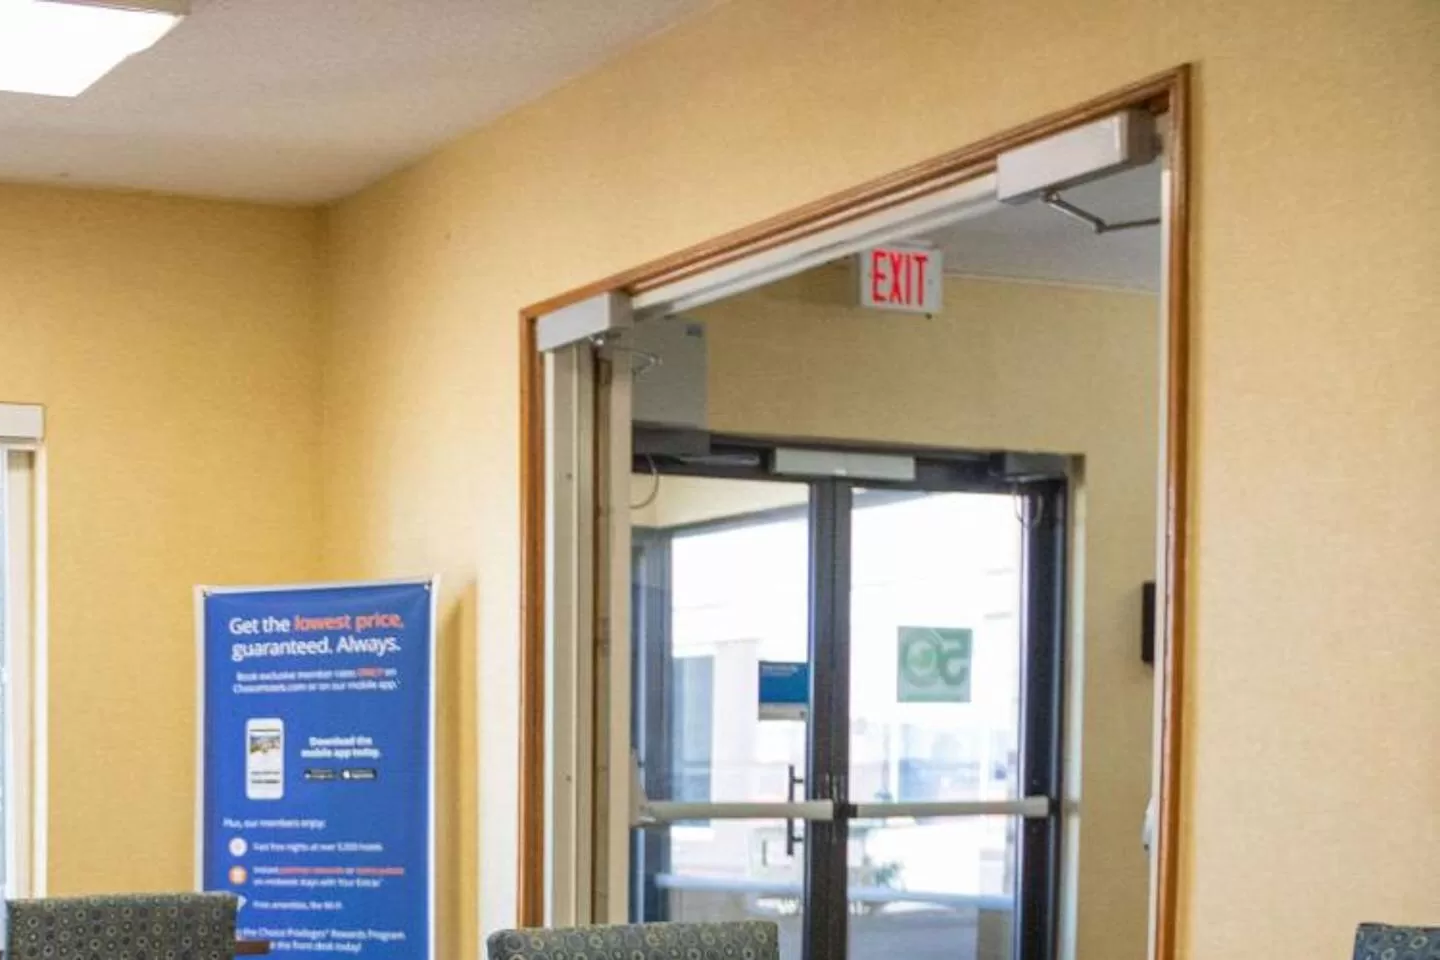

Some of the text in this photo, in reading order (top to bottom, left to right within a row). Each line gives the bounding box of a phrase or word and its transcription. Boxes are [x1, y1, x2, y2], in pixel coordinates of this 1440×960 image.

[871, 249, 928, 306] EXIT
[229, 617, 259, 634] Get
[262, 615, 290, 633] the
[294, 614, 351, 631] lowest
[231, 635, 402, 662] guaranteed. Always.
